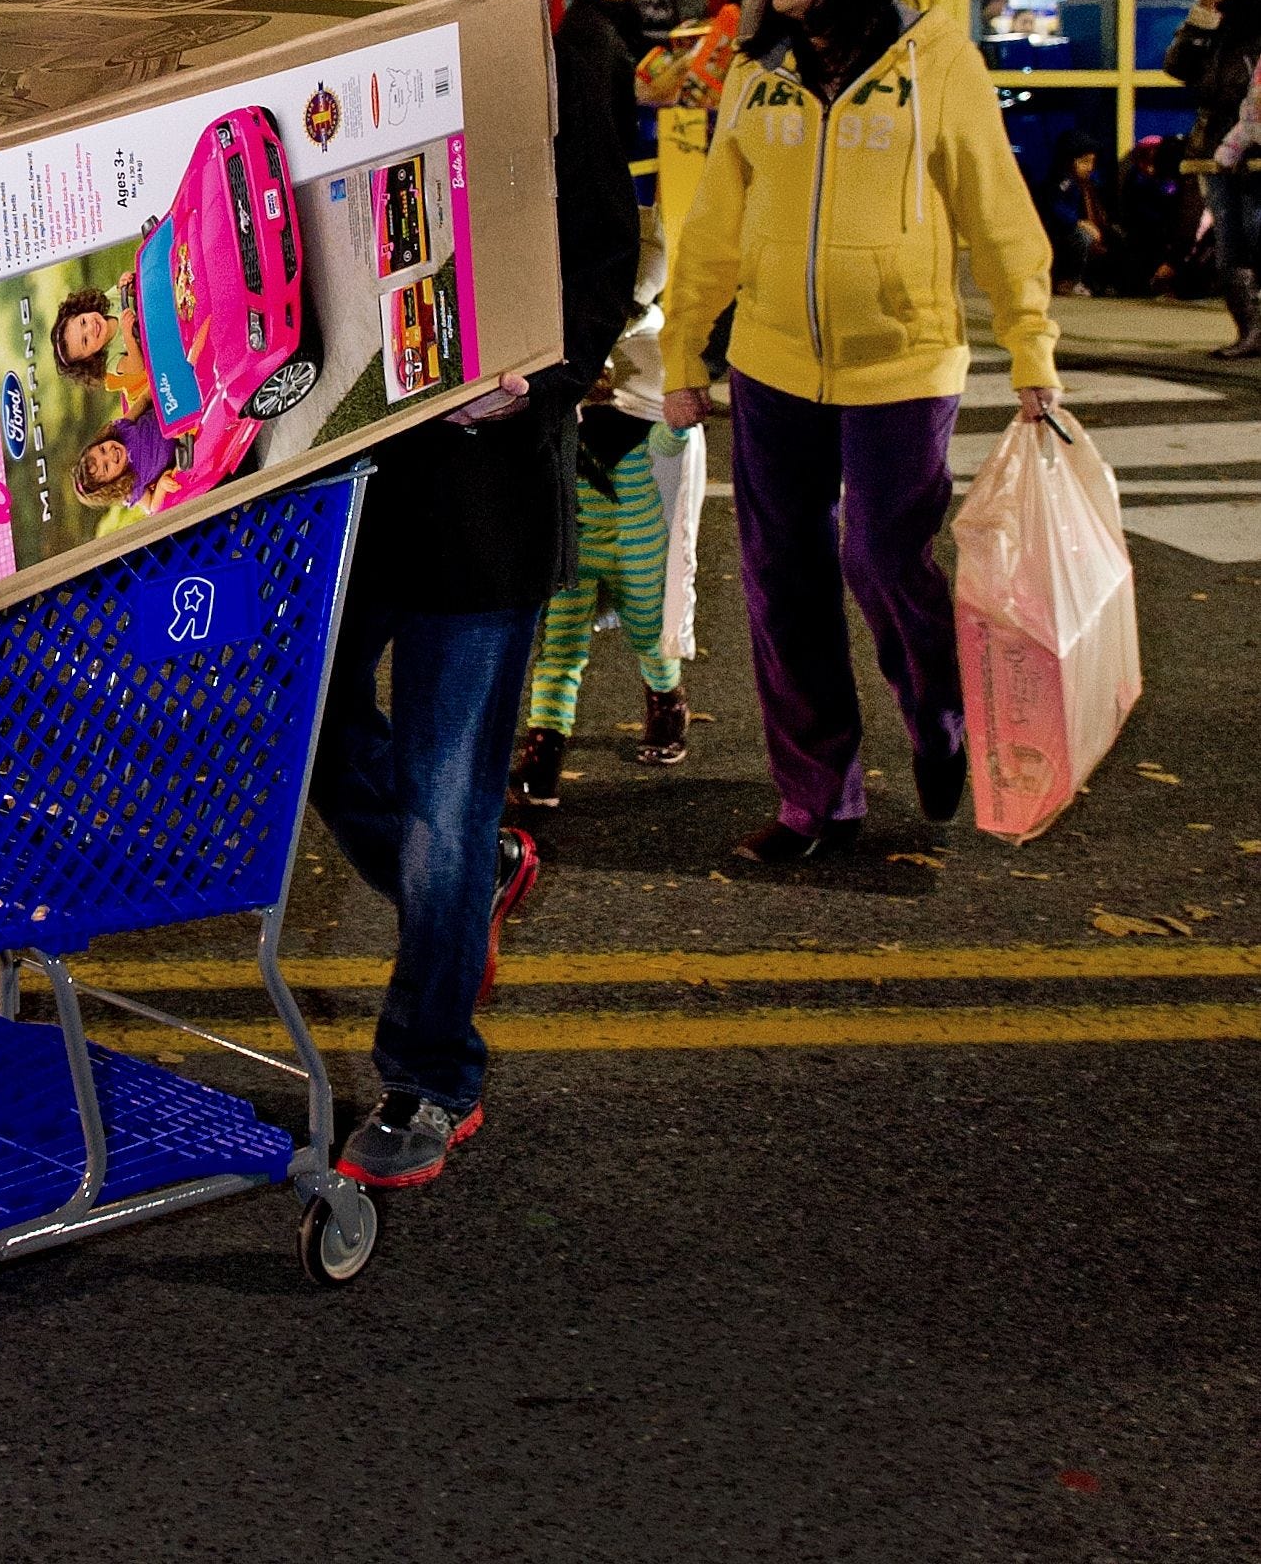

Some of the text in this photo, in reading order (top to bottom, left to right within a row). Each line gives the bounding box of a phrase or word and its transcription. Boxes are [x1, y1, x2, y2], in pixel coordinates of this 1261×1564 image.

[113, 148, 129, 207] Ages 3+
[452, 153, 464, 188] Barbie
[5, 389, 25, 442] Ford
[20, 297, 52, 523] MUSTANG
[159, 373, 178, 415] Barbie
